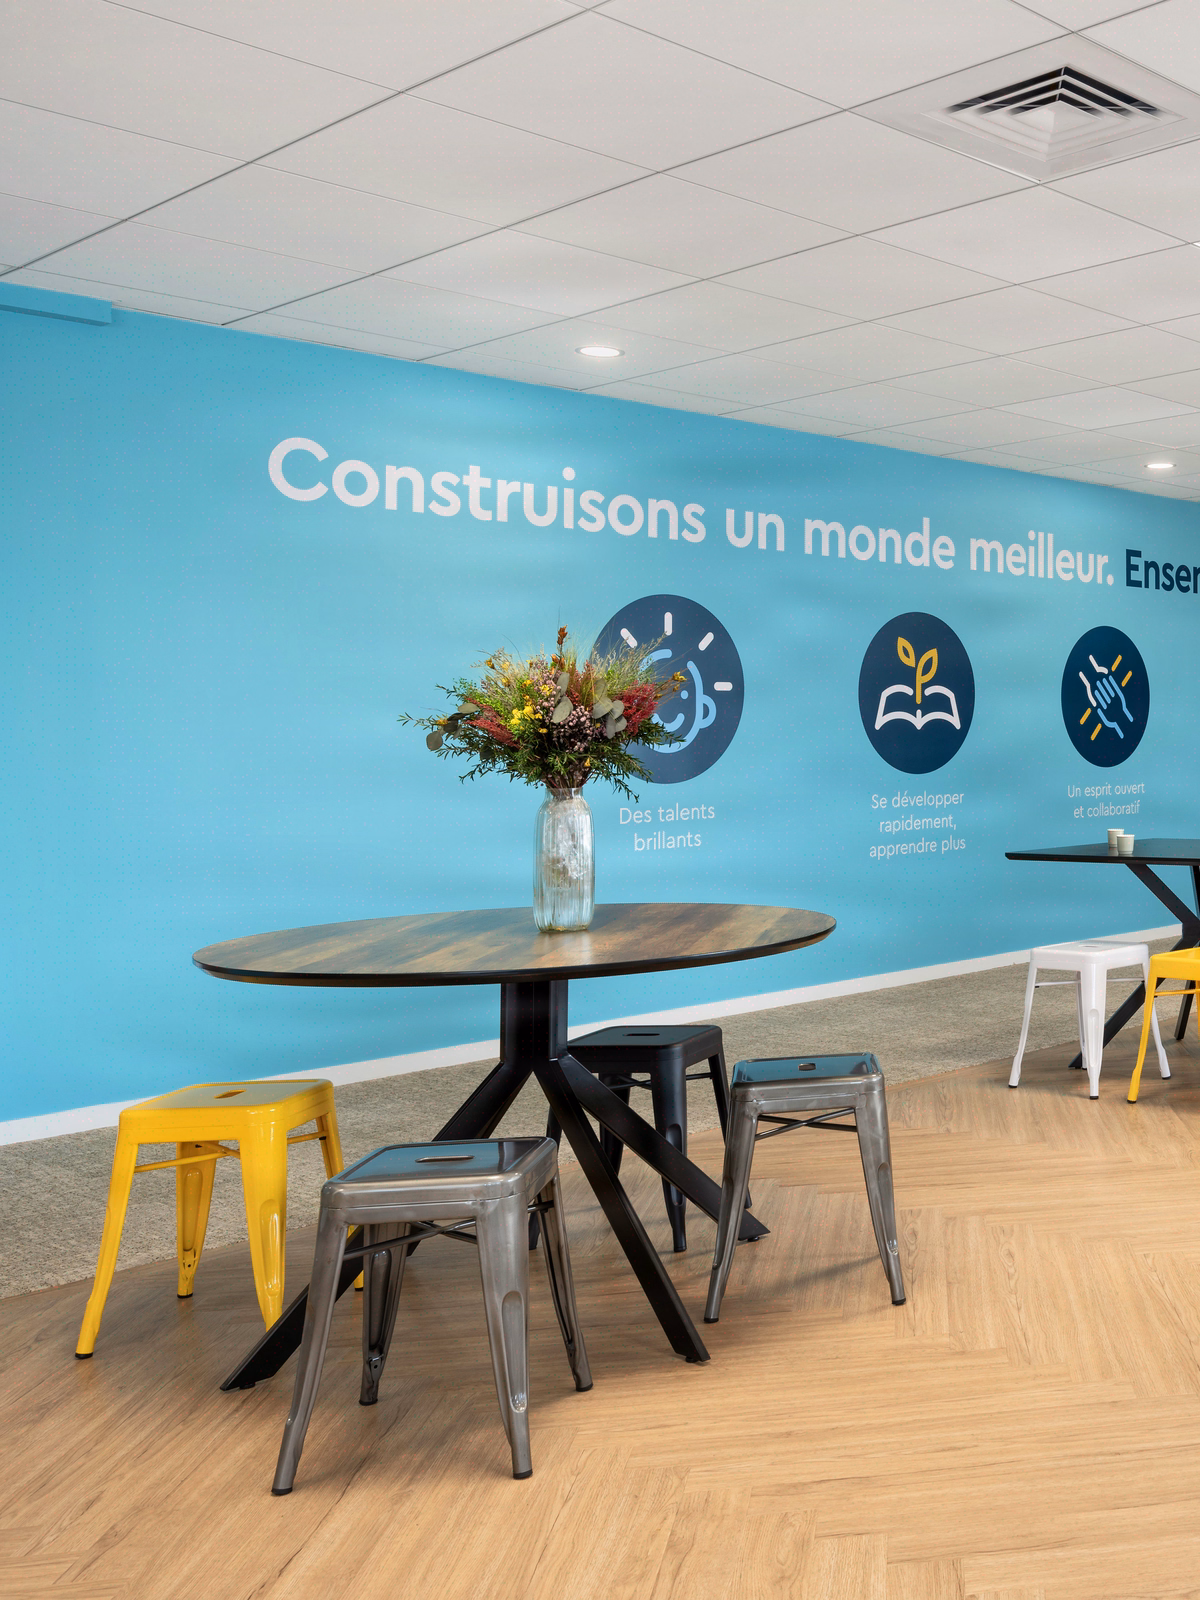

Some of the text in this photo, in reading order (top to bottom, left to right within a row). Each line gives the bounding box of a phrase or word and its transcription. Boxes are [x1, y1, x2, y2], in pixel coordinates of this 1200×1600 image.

[267, 436, 707, 543] Construisons
[725, 507, 785, 552] un
[804, 516, 956, 571] monde
[969, 529, 1115, 587] meilleur.
[871, 790, 965, 809] Se développer
[1067, 782, 1145, 799] Un esprit ouvert
[619, 802, 715, 825] Des talents
[1073, 799, 1141, 818] et collaboratif
[879, 814, 957, 835] rapidement,
[633, 830, 702, 852] brillants
[869, 834, 966, 861] apprendre plus
